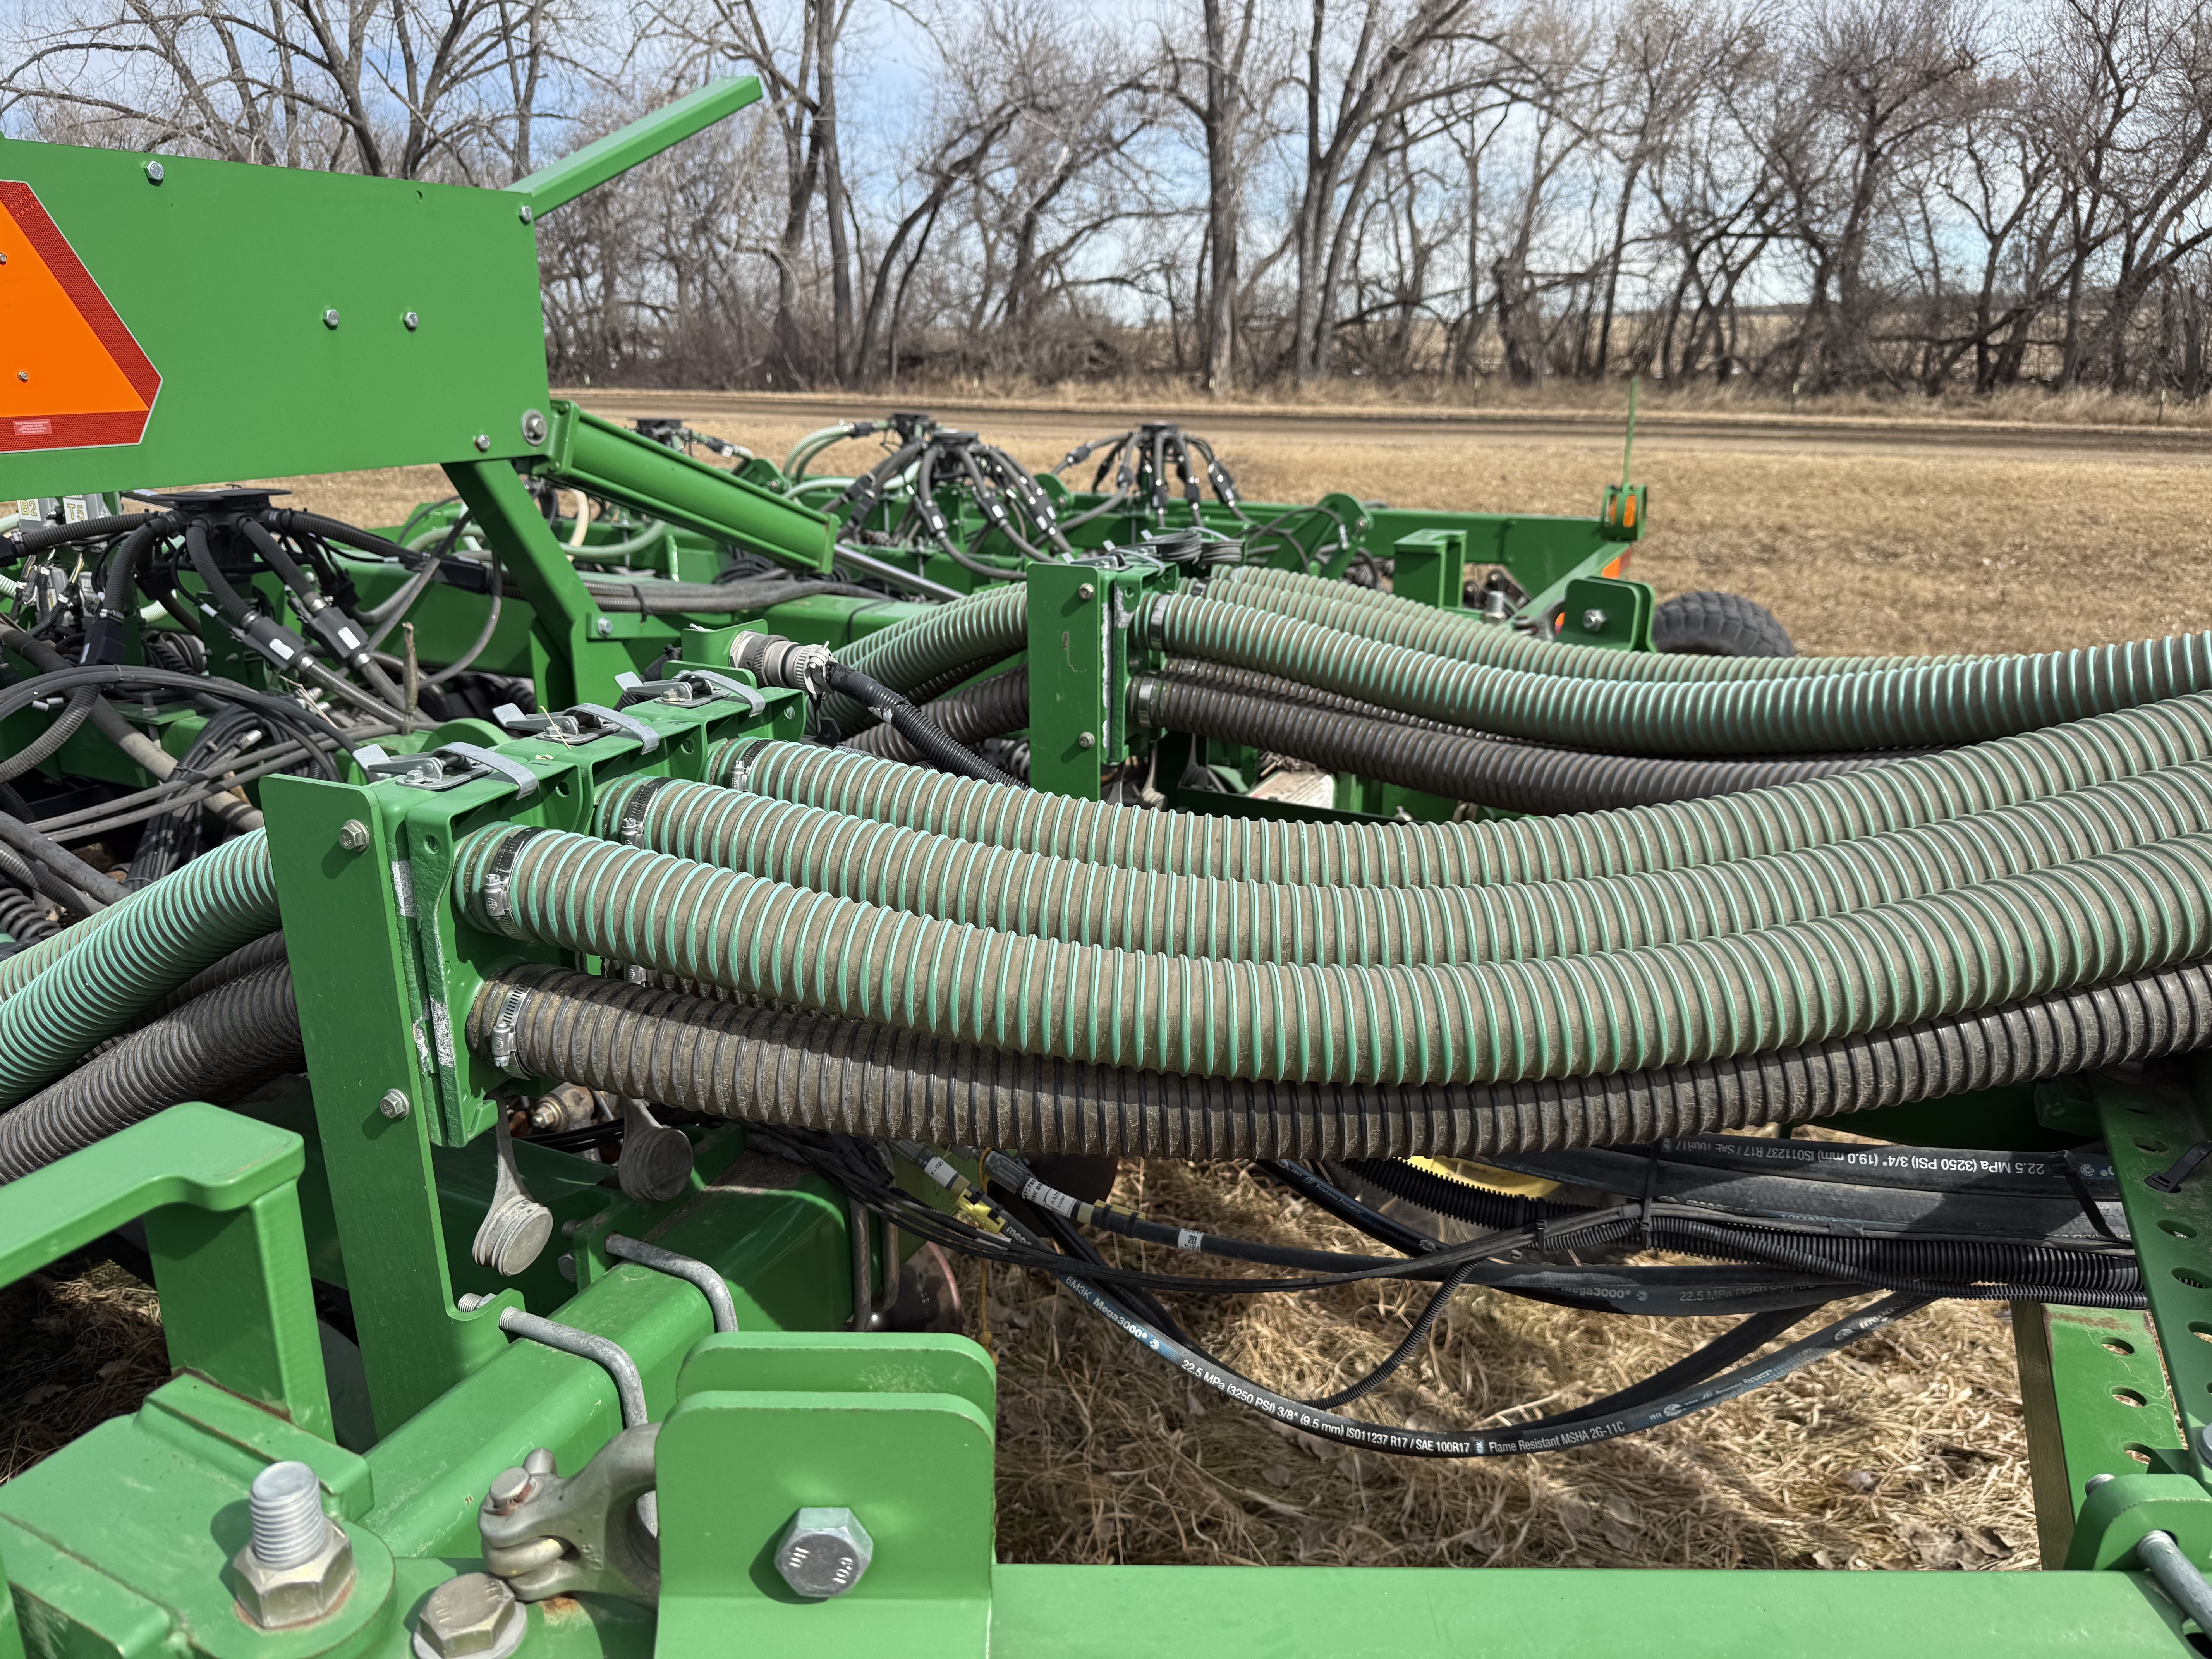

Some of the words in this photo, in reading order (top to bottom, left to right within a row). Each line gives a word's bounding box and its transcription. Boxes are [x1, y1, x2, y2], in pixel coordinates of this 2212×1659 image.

[21, 500, 38, 517] B2
[67, 503, 85, 521] T5
[1743, 1146, 1764, 1157] R17
[1817, 1149, 1845, 1163] mm)
[1847, 1152, 1879, 1166] (19.0
[1882, 1155, 1909, 1167] 3/4"
[1911, 1155, 1937, 1169] PSI)
[1941, 1158, 1977, 1173] (3250
[1980, 1161, 2011, 1173] MPa
[2015, 1162, 2045, 1175] 22.5
[1679, 1291, 1704, 1301] 22.5
[1707, 1290, 1733, 1300] MPa
[1066, 1276, 1092, 1300] 6M3K
[1181, 1359, 1204, 1377] 22.5
[1203, 1371, 1225, 1391] MPa
[1226, 1383, 1254, 1403] (3250
[1255, 1397, 1276, 1413] PSI)
[1277, 1406, 1298, 1420] 3/8"
[1300, 1413, 1320, 1428] (9.5
[1321, 1423, 1345, 1437] mm)
[1346, 1427, 1388, 1445] ISO11237
[1390, 1436, 1408, 1449] R17
[1415, 1439, 1434, 1451] SAE
[1436, 1441, 1470, 1453] 100R17
[1489, 1441, 1517, 1453] Flame
[1518, 1434, 1560, 1451] Resistant
[1561, 1429, 1590, 1445] MSHA
[1590, 1420, 1626, 1439] 2G-11C
